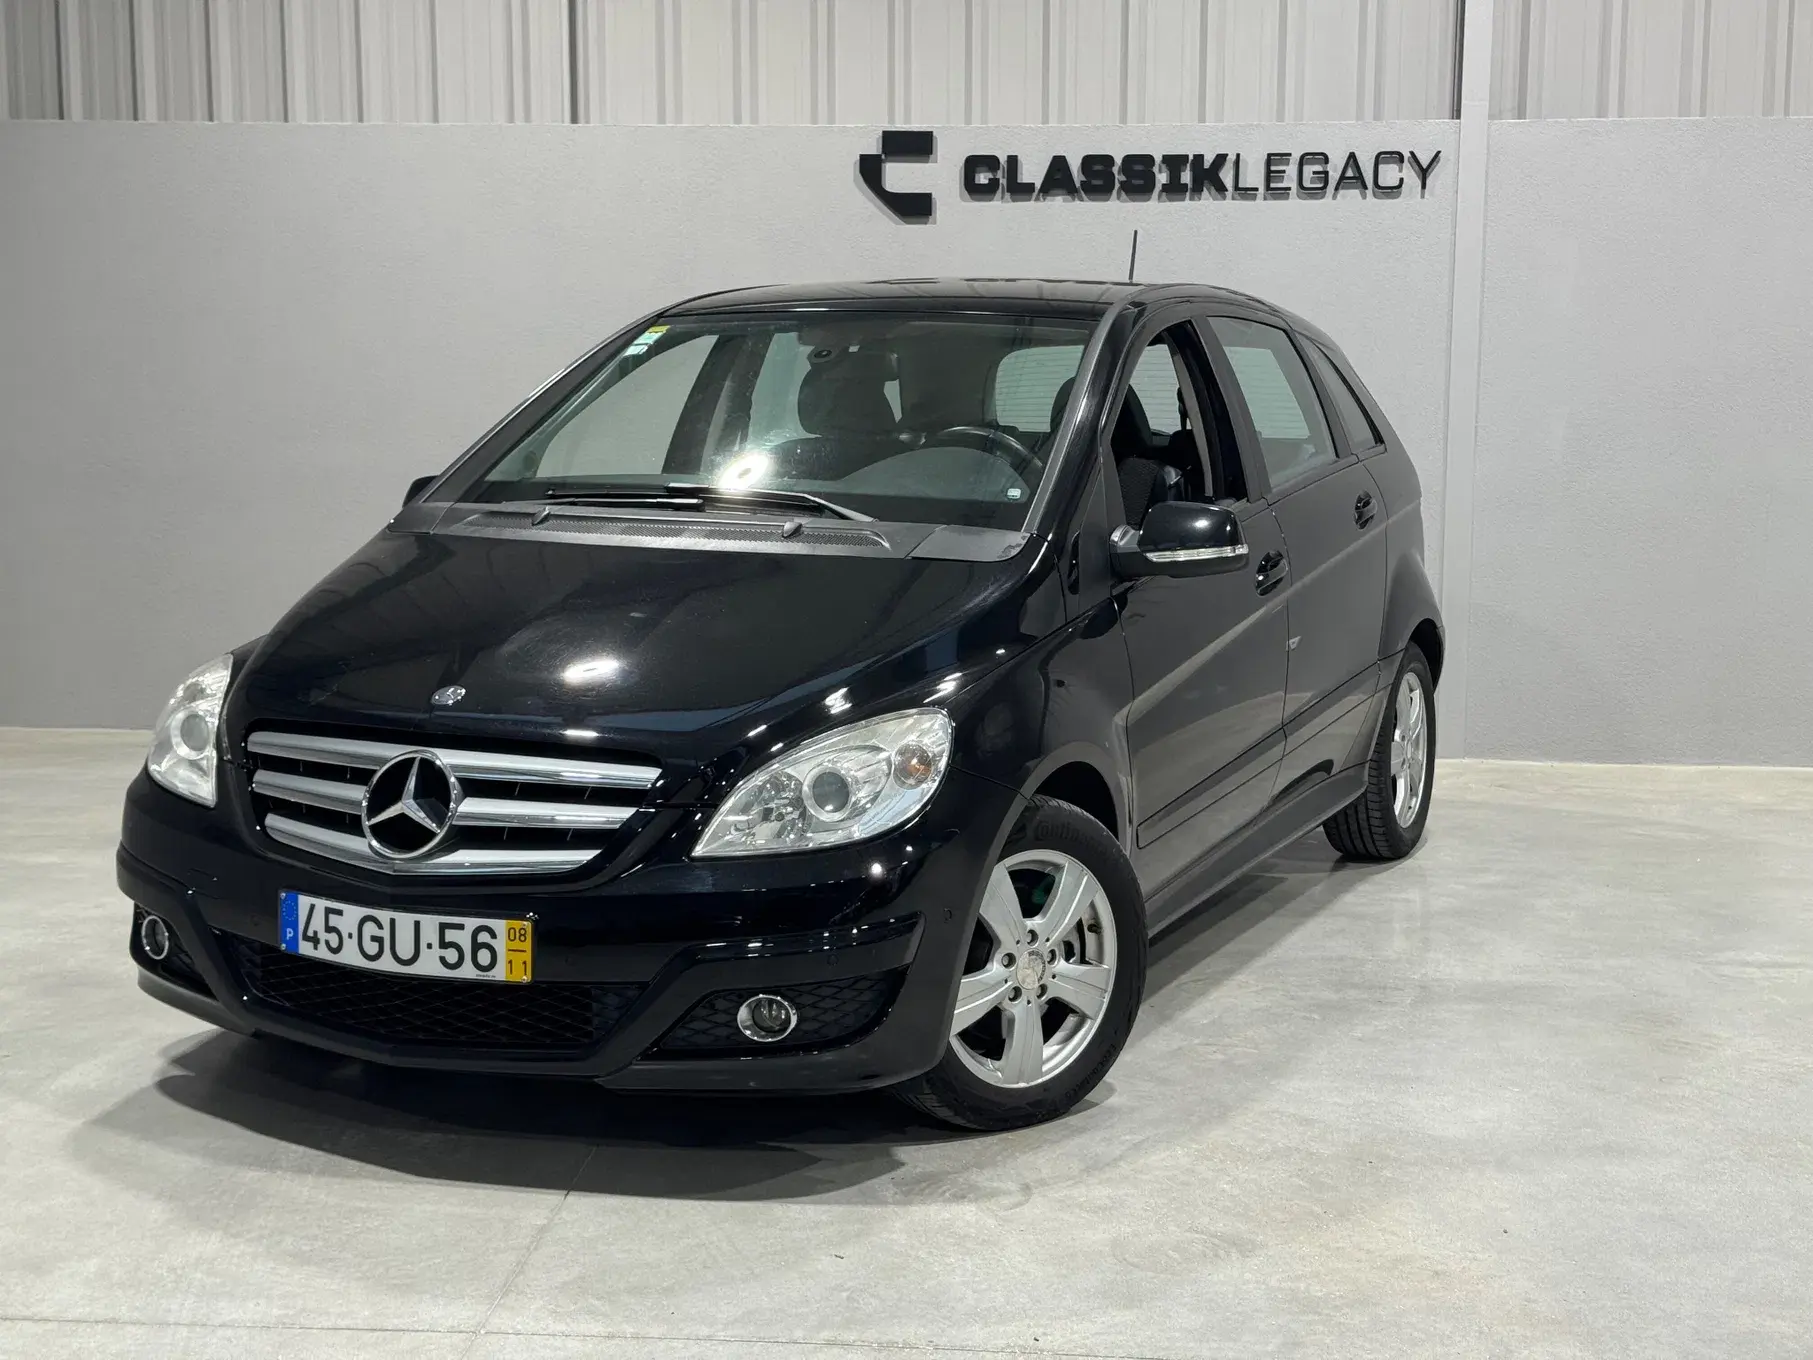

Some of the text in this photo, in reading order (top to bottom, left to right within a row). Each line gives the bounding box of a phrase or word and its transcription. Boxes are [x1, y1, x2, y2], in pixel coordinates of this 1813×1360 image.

[286, 927, 294, 941] P
[507, 926, 528, 943] 08
[507, 959, 528, 976] 11
